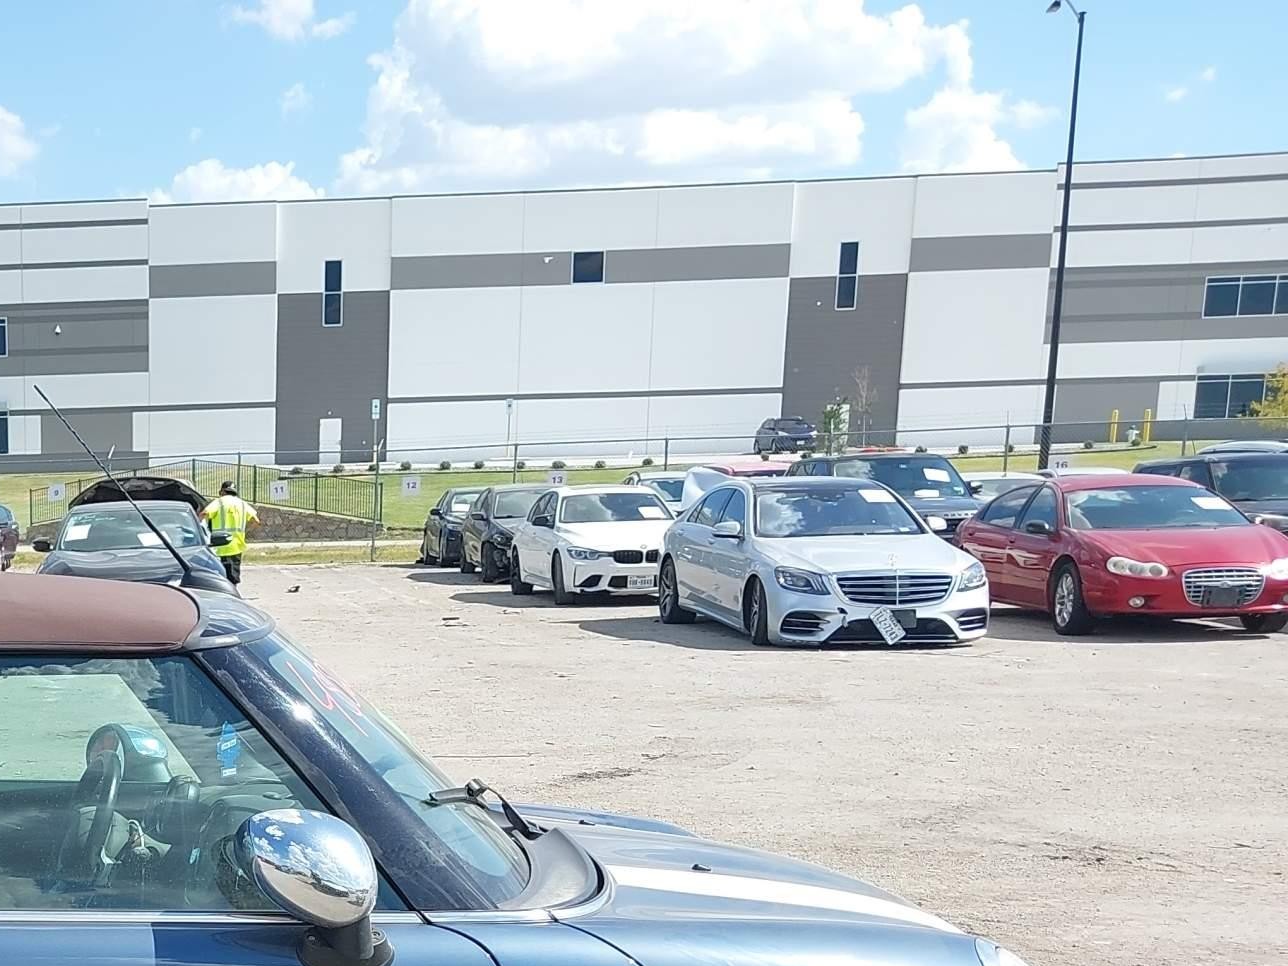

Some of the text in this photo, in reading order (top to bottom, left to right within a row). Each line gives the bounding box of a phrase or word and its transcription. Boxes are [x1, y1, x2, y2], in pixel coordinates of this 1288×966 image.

[1055, 461, 1069, 469] 16
[551, 475, 563, 484] 13
[407, 481, 417, 489] 12
[274, 486, 284, 494] 11
